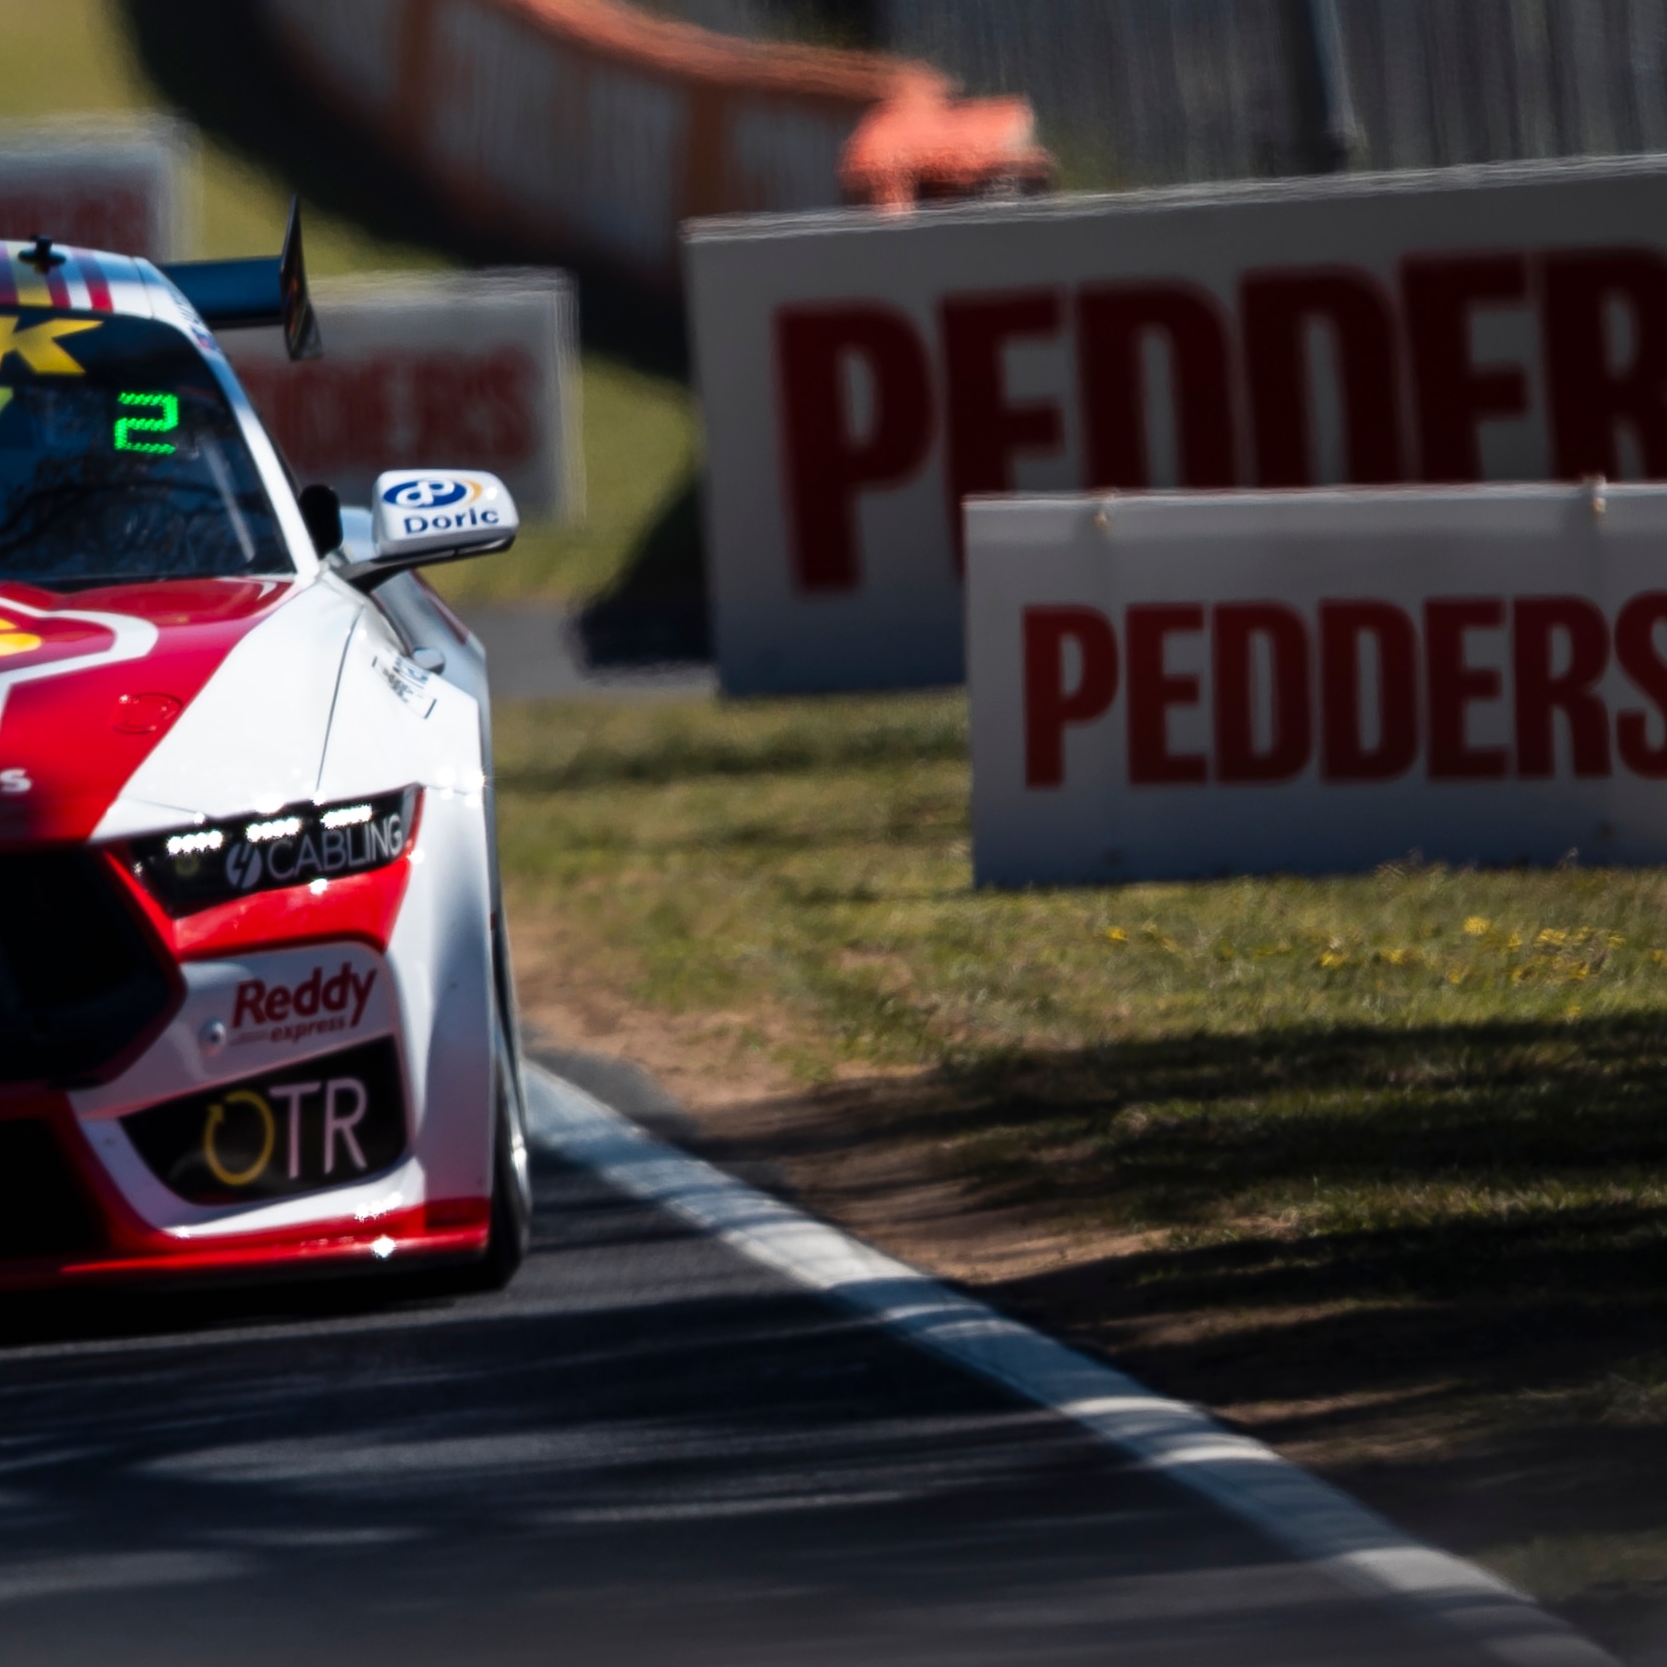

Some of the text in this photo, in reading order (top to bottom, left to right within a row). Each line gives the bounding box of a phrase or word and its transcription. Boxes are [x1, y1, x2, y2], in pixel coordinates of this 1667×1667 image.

[115, 392, 179, 454] 2
[403, 507, 500, 535] Doric
[1023, 590, 1667, 790] PEDDERS
[231, 961, 377, 1028] Reddy
[270, 1016, 345, 1043] express
[202, 1074, 369, 1187] OTR
